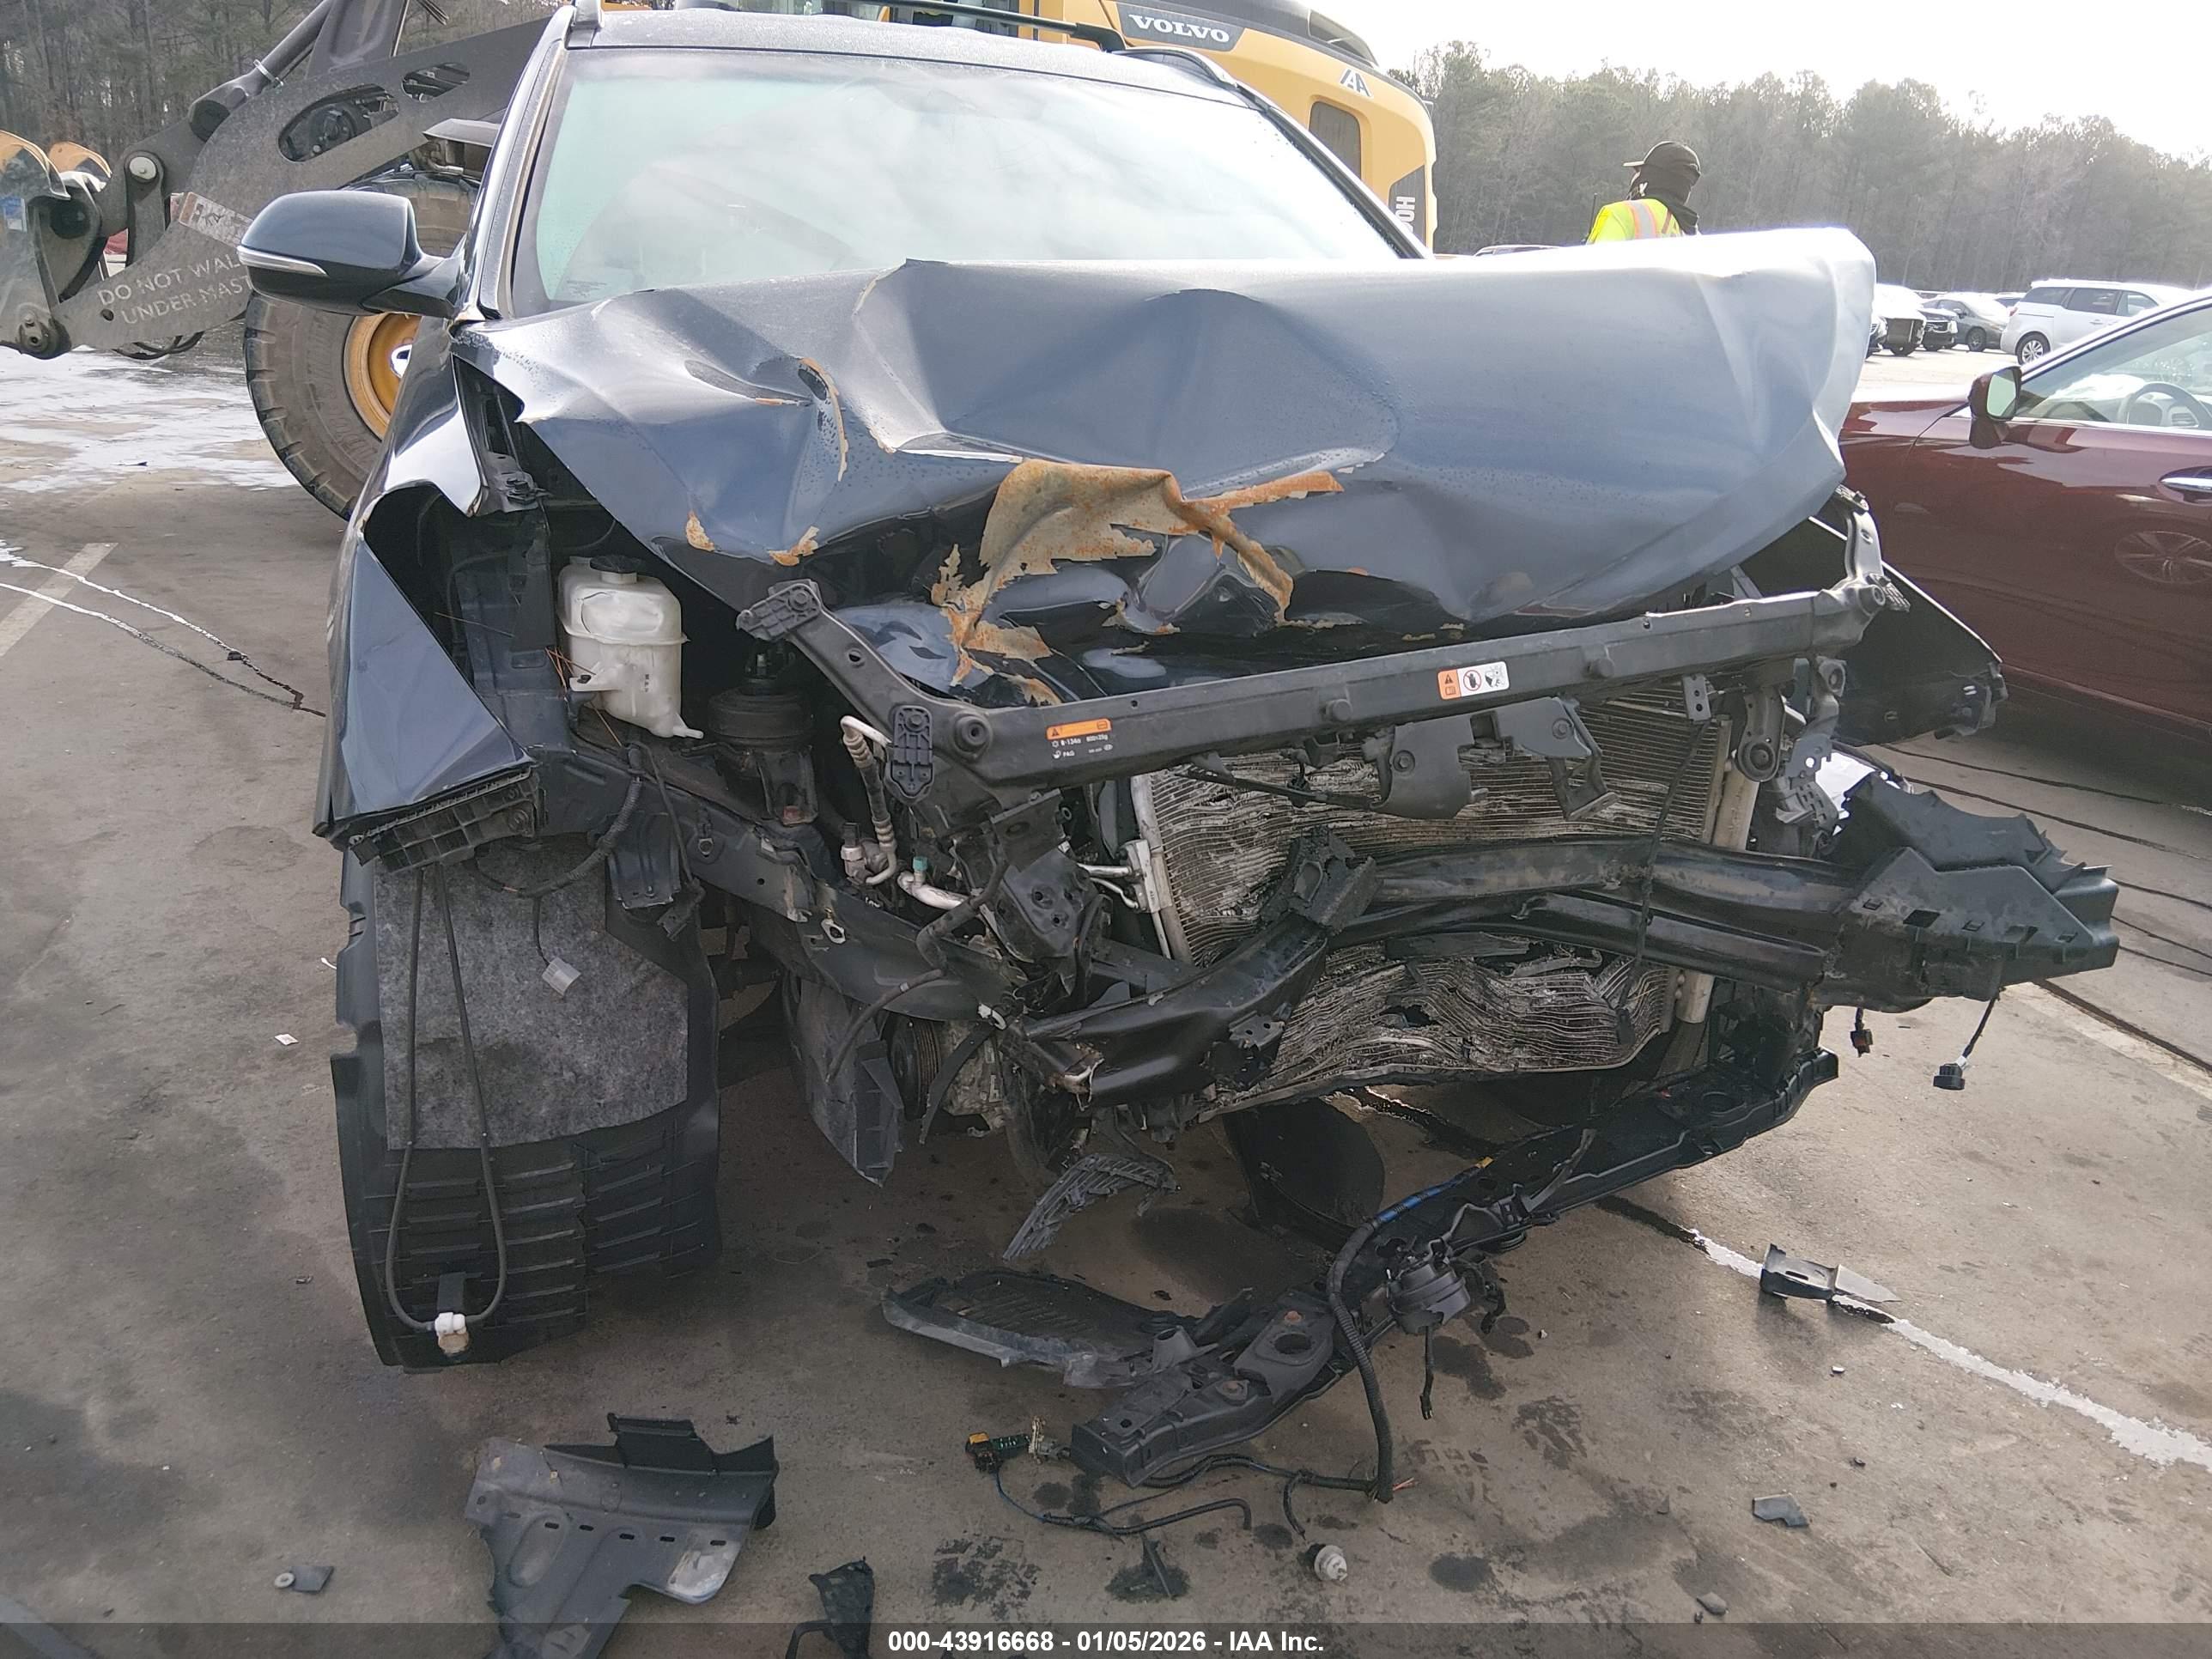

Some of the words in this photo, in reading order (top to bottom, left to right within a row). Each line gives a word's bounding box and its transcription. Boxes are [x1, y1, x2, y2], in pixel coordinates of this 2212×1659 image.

[1128, 14, 1230, 43] VOLVO
[96, 283, 132, 306] DO
[135, 267, 184, 295] NOT
[187, 253, 243, 278] WAL
[121, 292, 198, 325] UNDER
[198, 275, 254, 304] MAST
